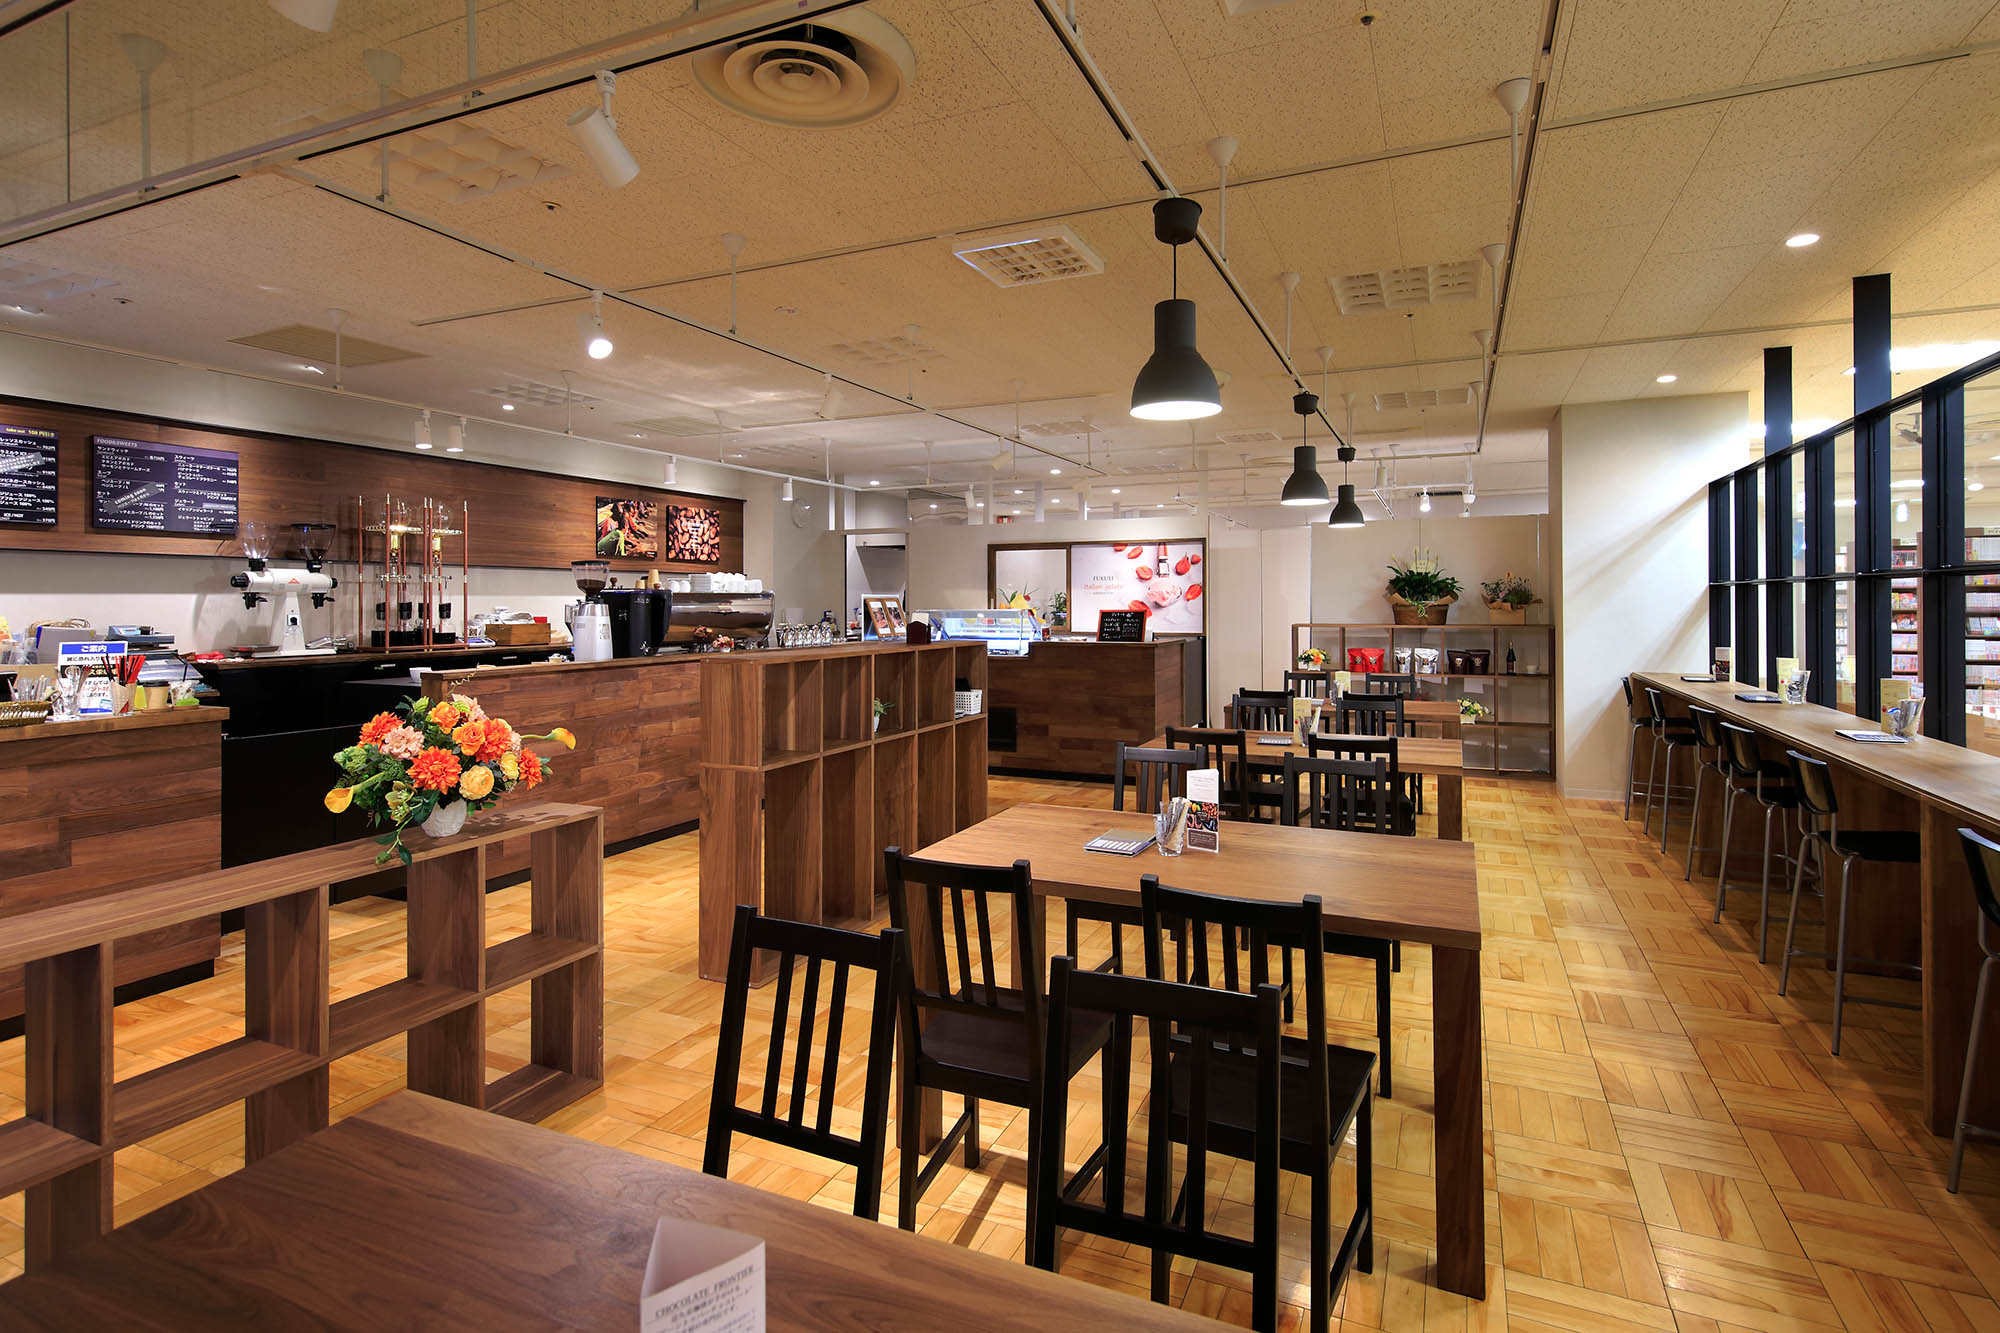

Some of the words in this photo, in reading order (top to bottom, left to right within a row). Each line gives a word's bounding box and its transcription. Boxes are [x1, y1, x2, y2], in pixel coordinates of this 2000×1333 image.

[81, 645, 108, 653] ご案内
[655, 1287, 709, 1320] CHOCOLATE
